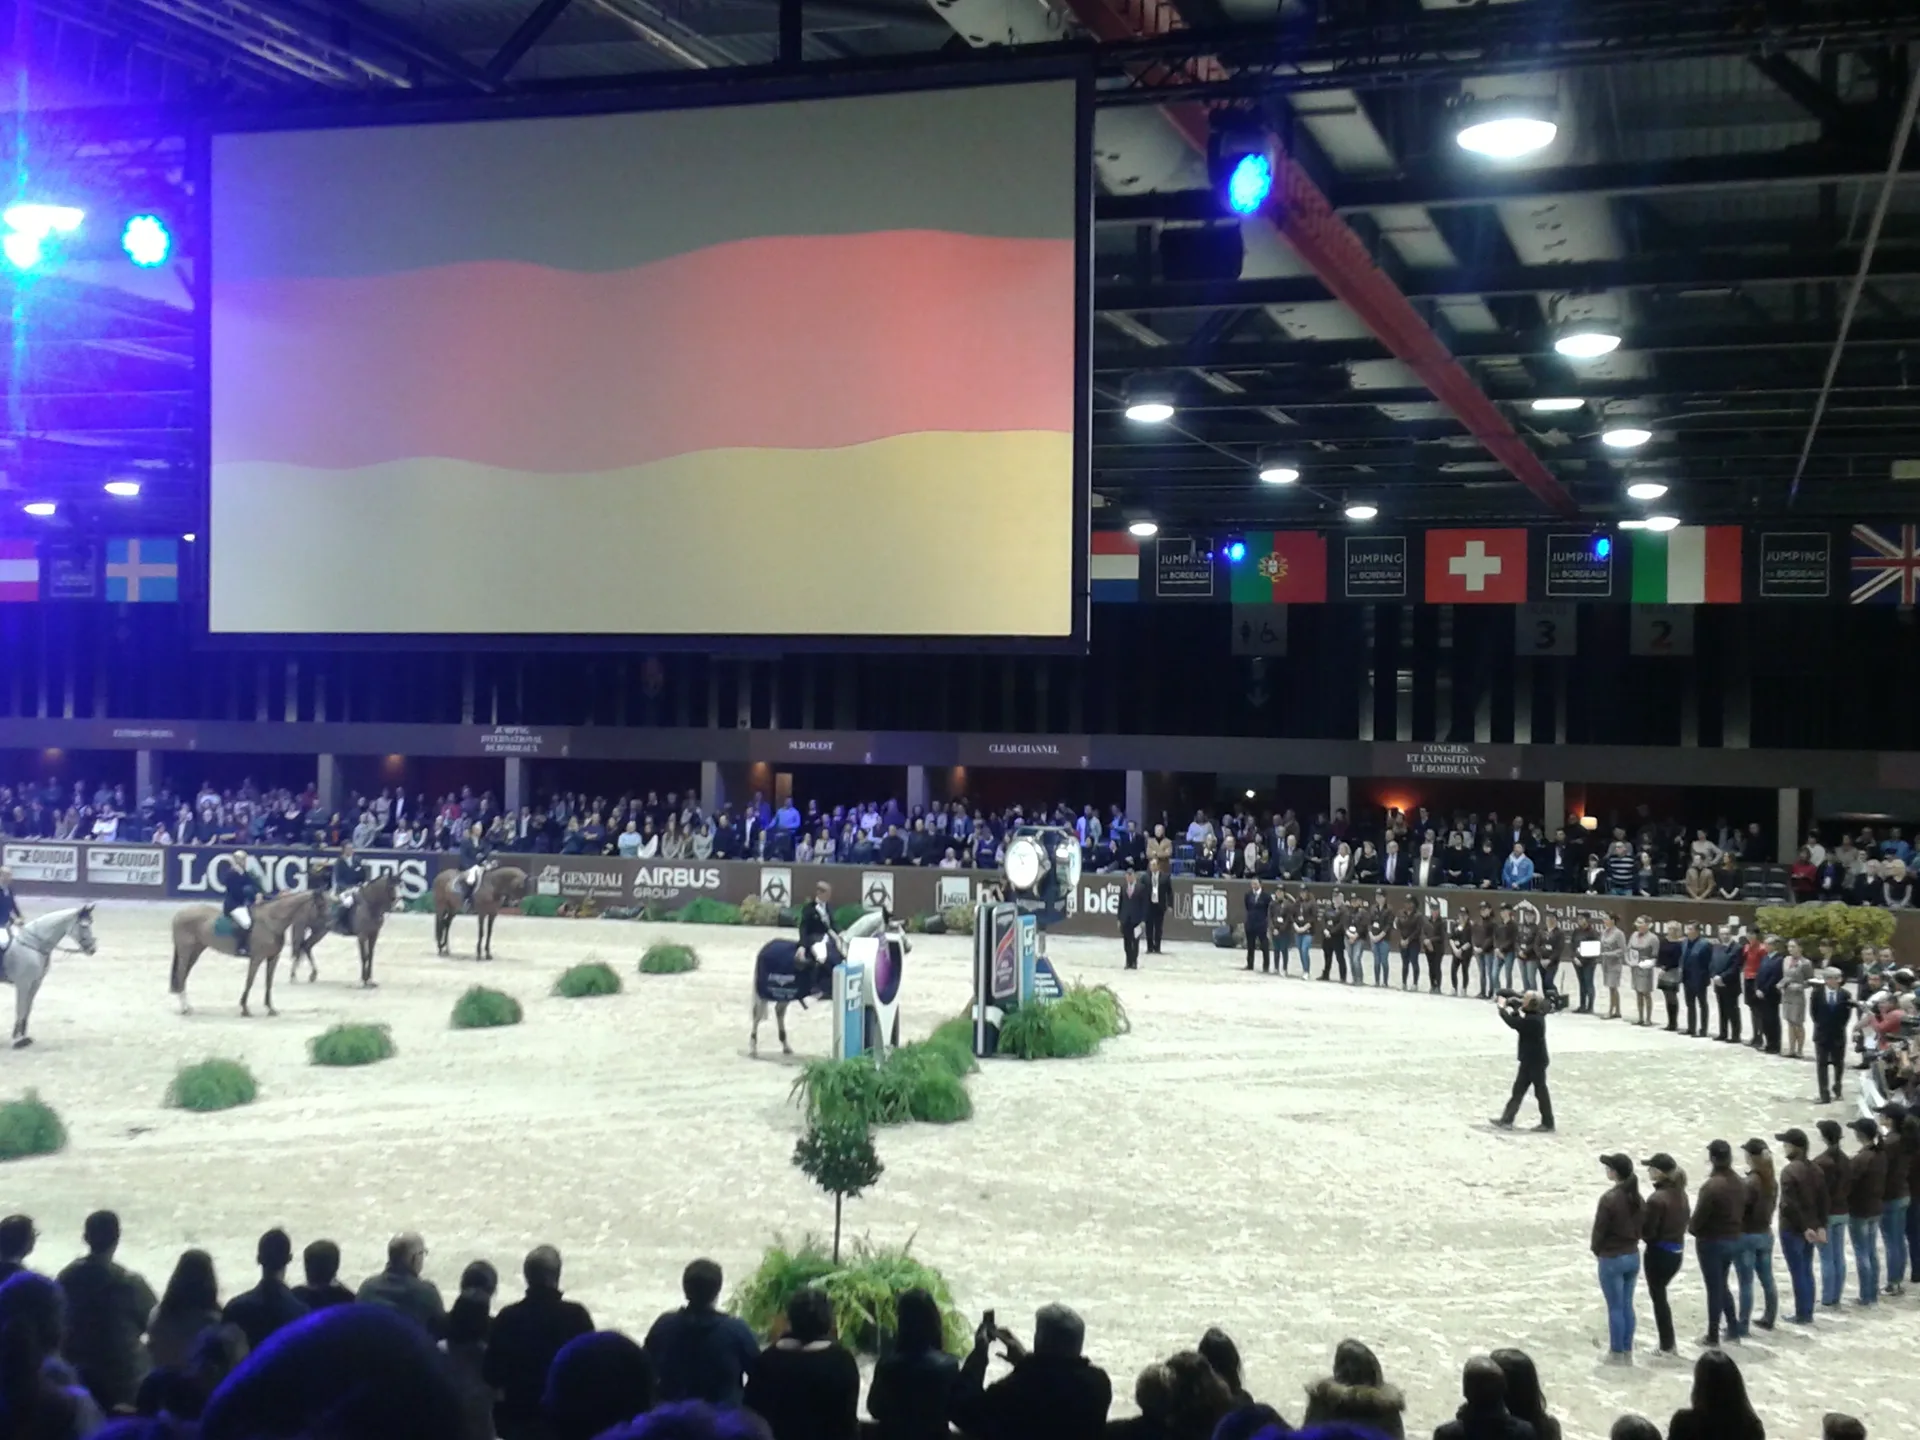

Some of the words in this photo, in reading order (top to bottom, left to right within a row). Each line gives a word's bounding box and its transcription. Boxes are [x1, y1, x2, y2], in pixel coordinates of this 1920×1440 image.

[1350, 554, 1404, 564] JUMPING
[1766, 551, 1826, 561] JUMPING
[1535, 620, 1557, 649] 3
[1651, 621, 1673, 649] 2
[988, 744, 1017, 753] CLEAR
[1018, 744, 1060, 755] CHANNEL
[1406, 754, 1419, 763] ET
[1420, 754, 1486, 765] EXPOSITIONS
[1412, 764, 1425, 773] DE
[1426, 764, 1480, 775] BORDEAUX
[20, 848, 75, 865] EQUIDIA
[103, 850, 160, 867] EQUIDIA
[41, 867, 75, 880] LIFE
[126, 870, 159, 883] LIFE
[177, 852, 428, 899] LONGES
[561, 870, 623, 888] GENERALI
[634, 866, 721, 889] AIRBUS
[633, 887, 680, 899] GROUP
[1084, 887, 1120, 914] ble
[1192, 894, 1227, 921] CUB
